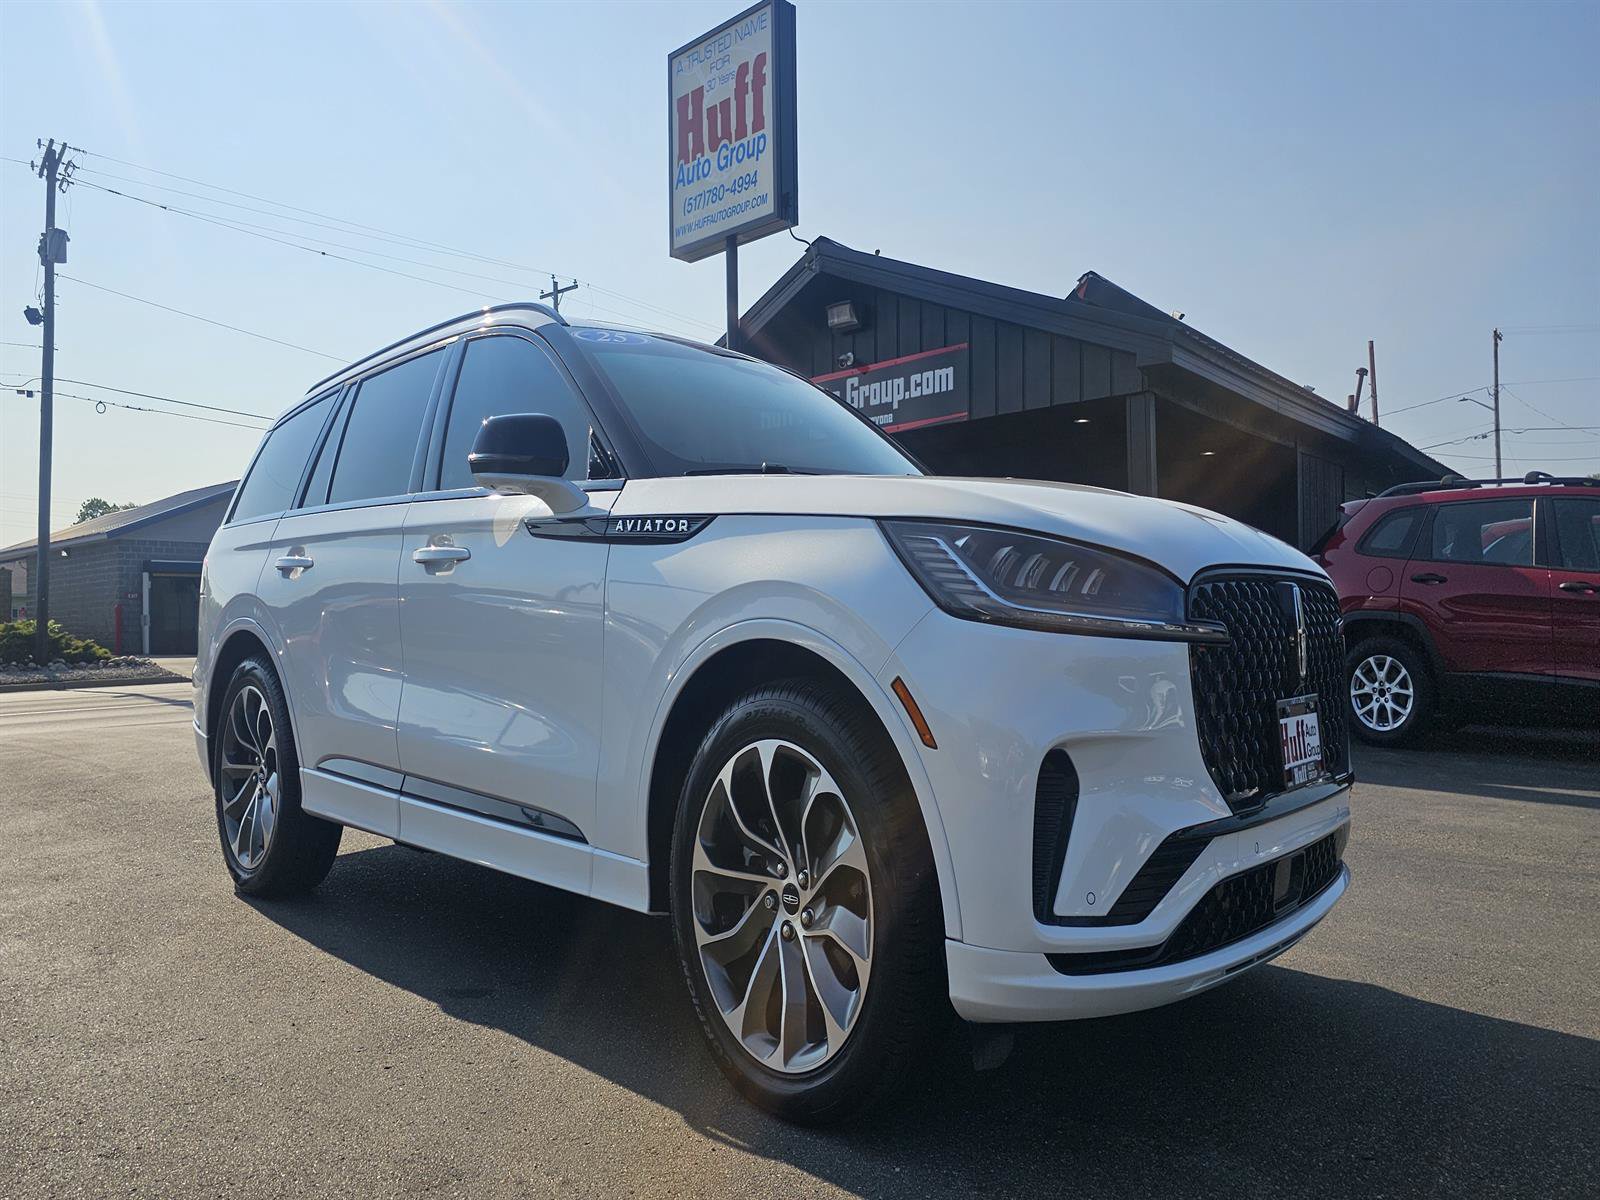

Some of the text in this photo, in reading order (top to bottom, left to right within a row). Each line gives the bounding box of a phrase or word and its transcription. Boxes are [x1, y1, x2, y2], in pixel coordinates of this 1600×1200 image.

[676, 13, 767, 76] A TRUSTED NAME
[709, 54, 731, 74] FOR
[718, 70, 736, 86] Years
[676, 52, 767, 166] Huff
[675, 133, 767, 190] Auto Group
[675, 193, 768, 238] WWW.HUFFAUTOGROUP.COM
[683, 170, 758, 217] (517)780-4994
[846, 366, 954, 410] Group.com
[615, 519, 688, 532] AVIATOR
[1280, 720, 1307, 764] Huff
[1305, 723, 1317, 738] Auto
